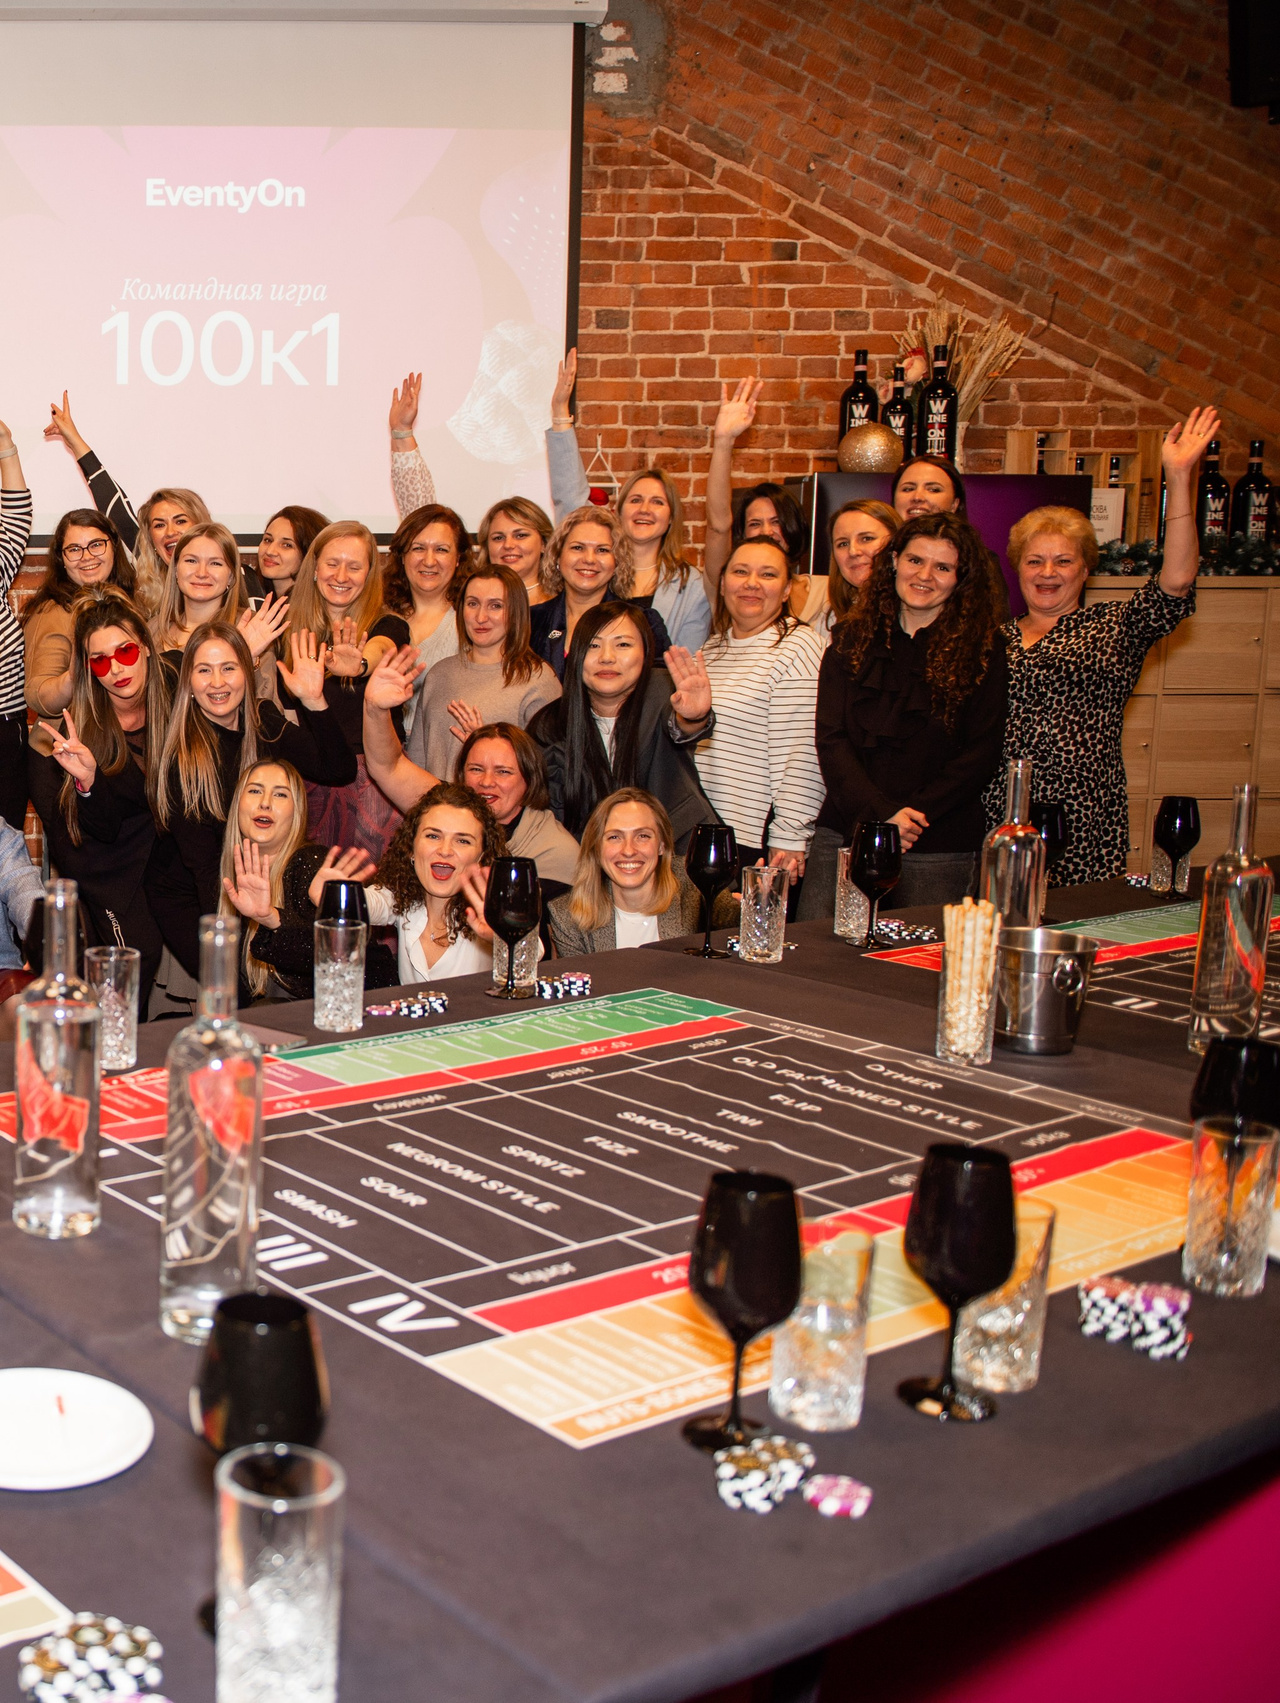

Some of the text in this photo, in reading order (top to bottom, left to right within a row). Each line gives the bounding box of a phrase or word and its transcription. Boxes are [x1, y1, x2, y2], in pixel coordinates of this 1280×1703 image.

[145, 178, 306, 213] EventyOn
[120, 277, 328, 306] Командная игра
[732, 1055, 778, 1072] OLD
[901, 1102, 984, 1131] STYLE
[865, 1062, 944, 1091] OTHER
[715, 1107, 764, 1128] TINI
[769, 1092, 823, 1114] FLIP
[583, 1134, 640, 1158] FIZZ
[616, 1110, 740, 1154] SMOOTHIE
[386, 1141, 562, 1215] NEGRONI STYLE
[501, 1144, 587, 1179] SPRITZ
[273, 1188, 359, 1230] SMASH
[359, 1175, 429, 1208] SOUR
[347, 1292, 461, 1334] IV
